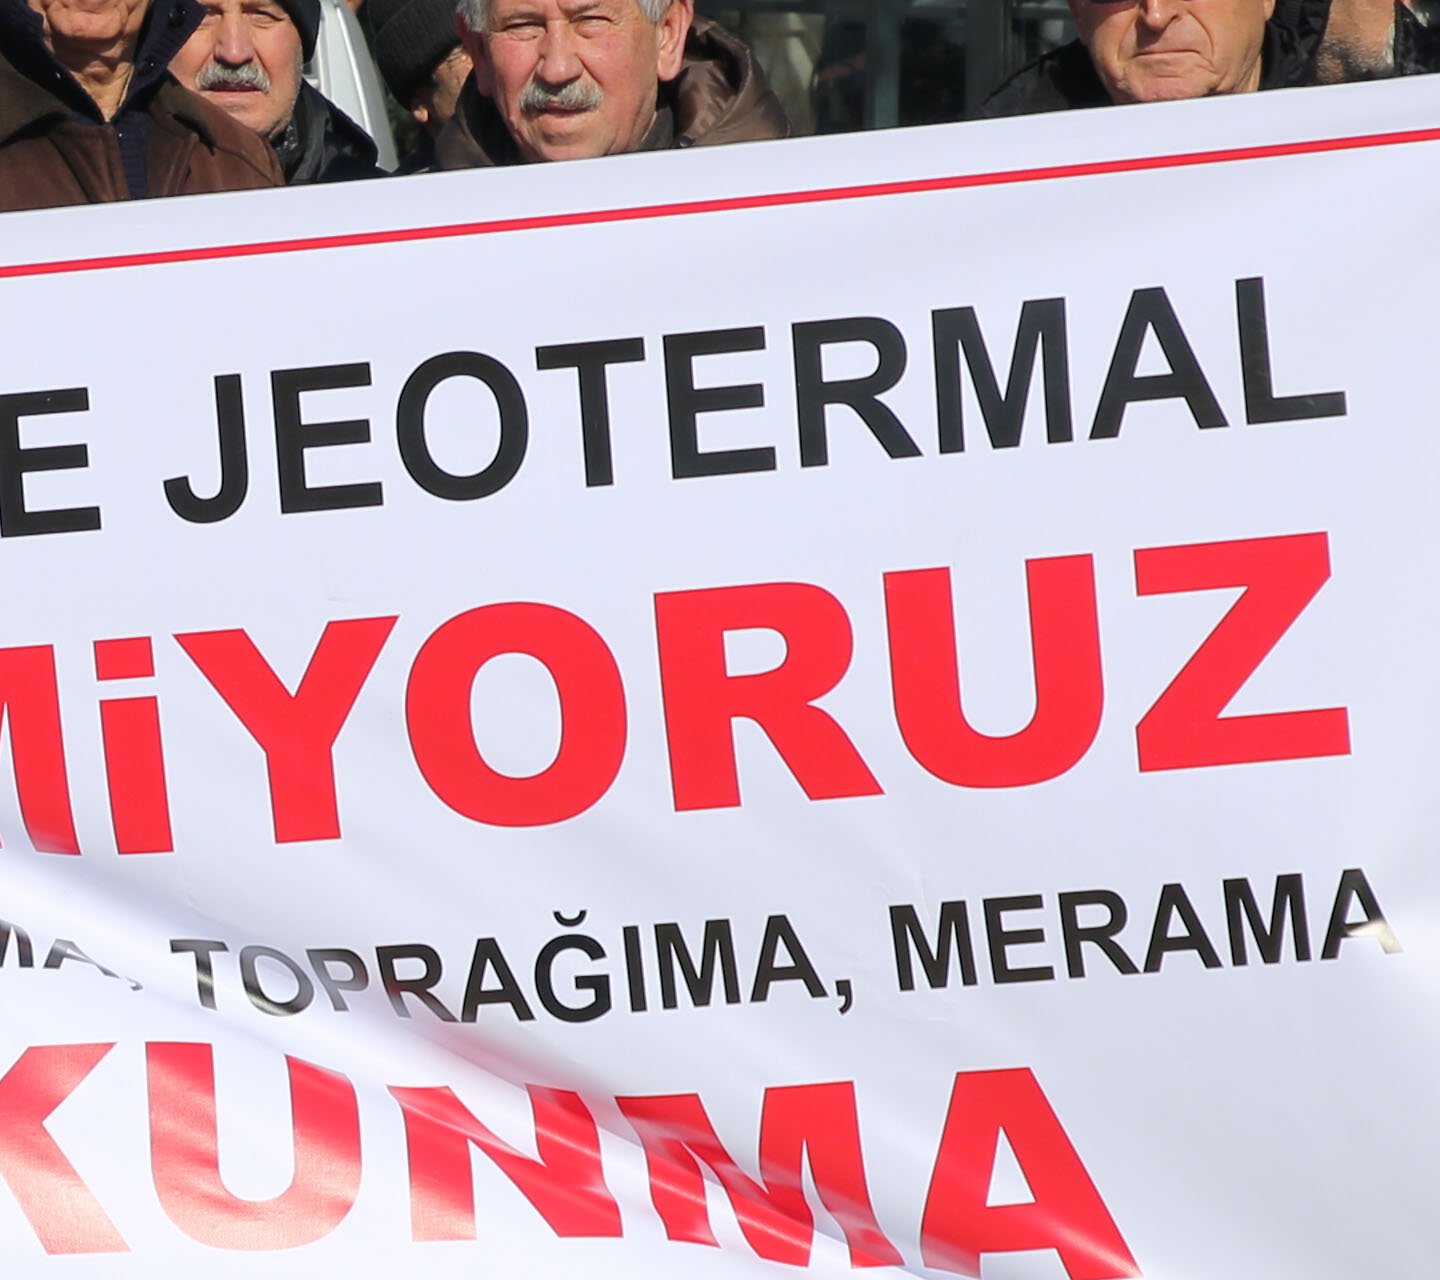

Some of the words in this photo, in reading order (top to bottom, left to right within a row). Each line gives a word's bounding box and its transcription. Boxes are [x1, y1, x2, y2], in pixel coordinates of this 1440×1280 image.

[162, 275, 1348, 524] JEOTERMAL
[170, 910, 853, 1025] TOPRAĞIMA,
[891, 866, 1402, 994] MERAMA
